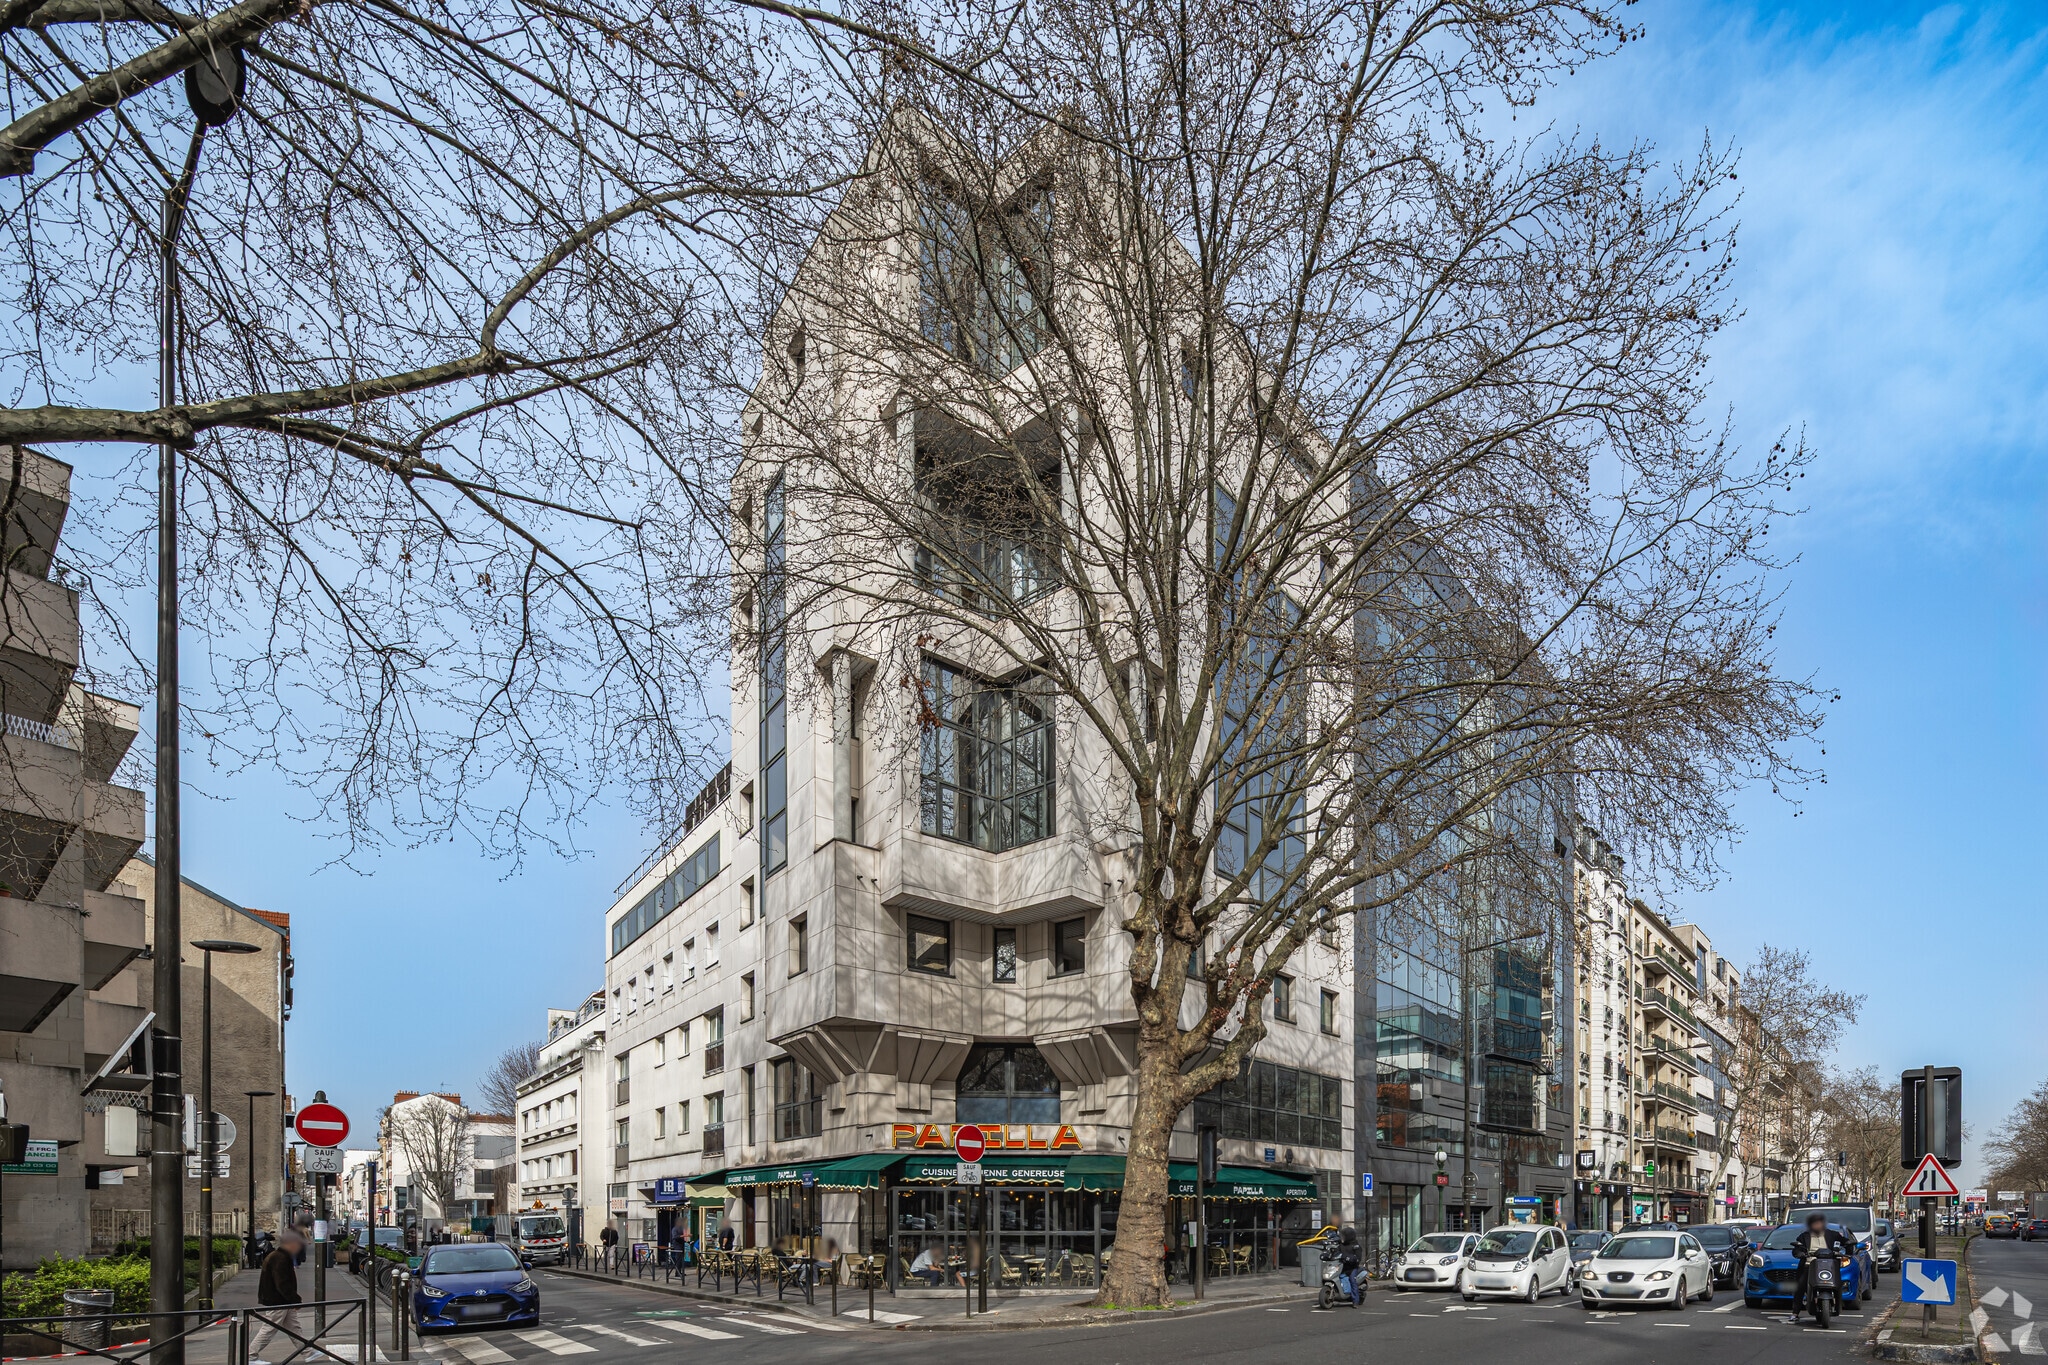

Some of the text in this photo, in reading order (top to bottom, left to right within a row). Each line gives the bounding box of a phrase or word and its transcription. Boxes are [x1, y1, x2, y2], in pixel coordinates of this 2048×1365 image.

[921, 1168, 957, 1176] CUISINE
[1012, 1169, 1065, 1178] GENEREUSE
[1233, 1186, 1264, 1195] PAPILLA
